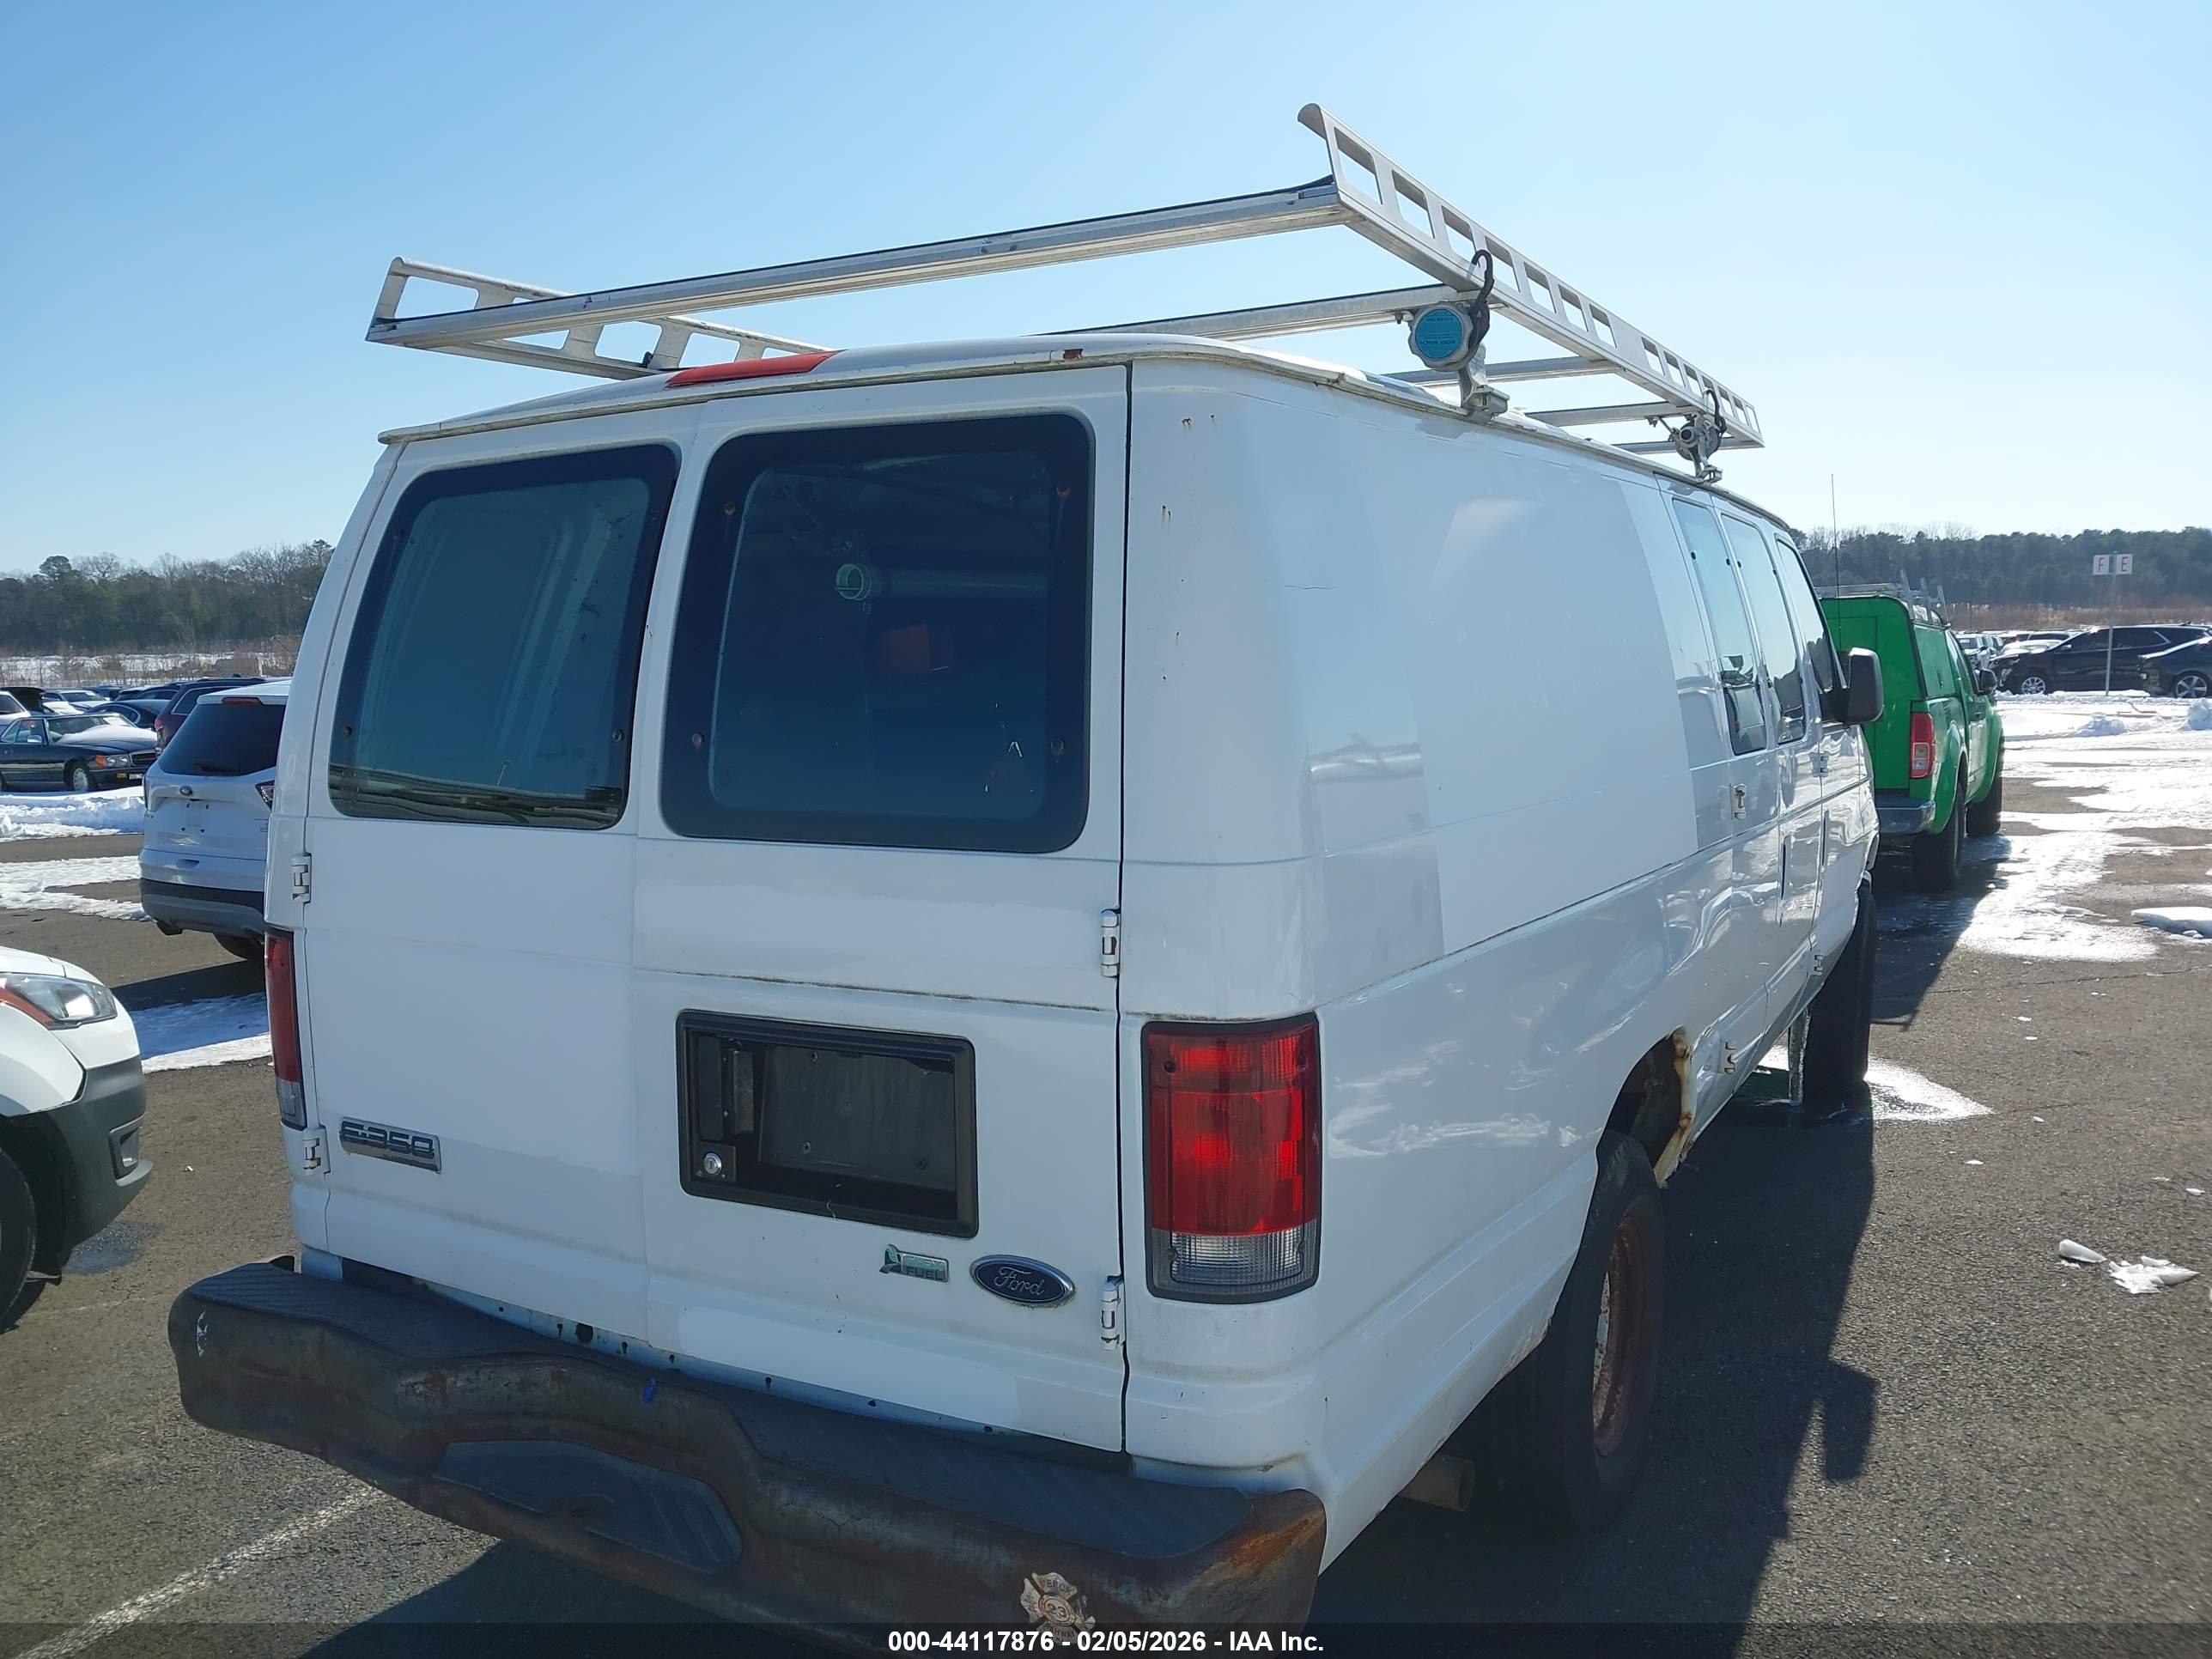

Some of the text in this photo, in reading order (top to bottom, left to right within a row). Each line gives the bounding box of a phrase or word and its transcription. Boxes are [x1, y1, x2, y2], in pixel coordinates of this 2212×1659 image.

[2121, 556, 2129, 572] E
[994, 1267, 1045, 1295] Ford
[1048, 1602, 1066, 1618] 23
